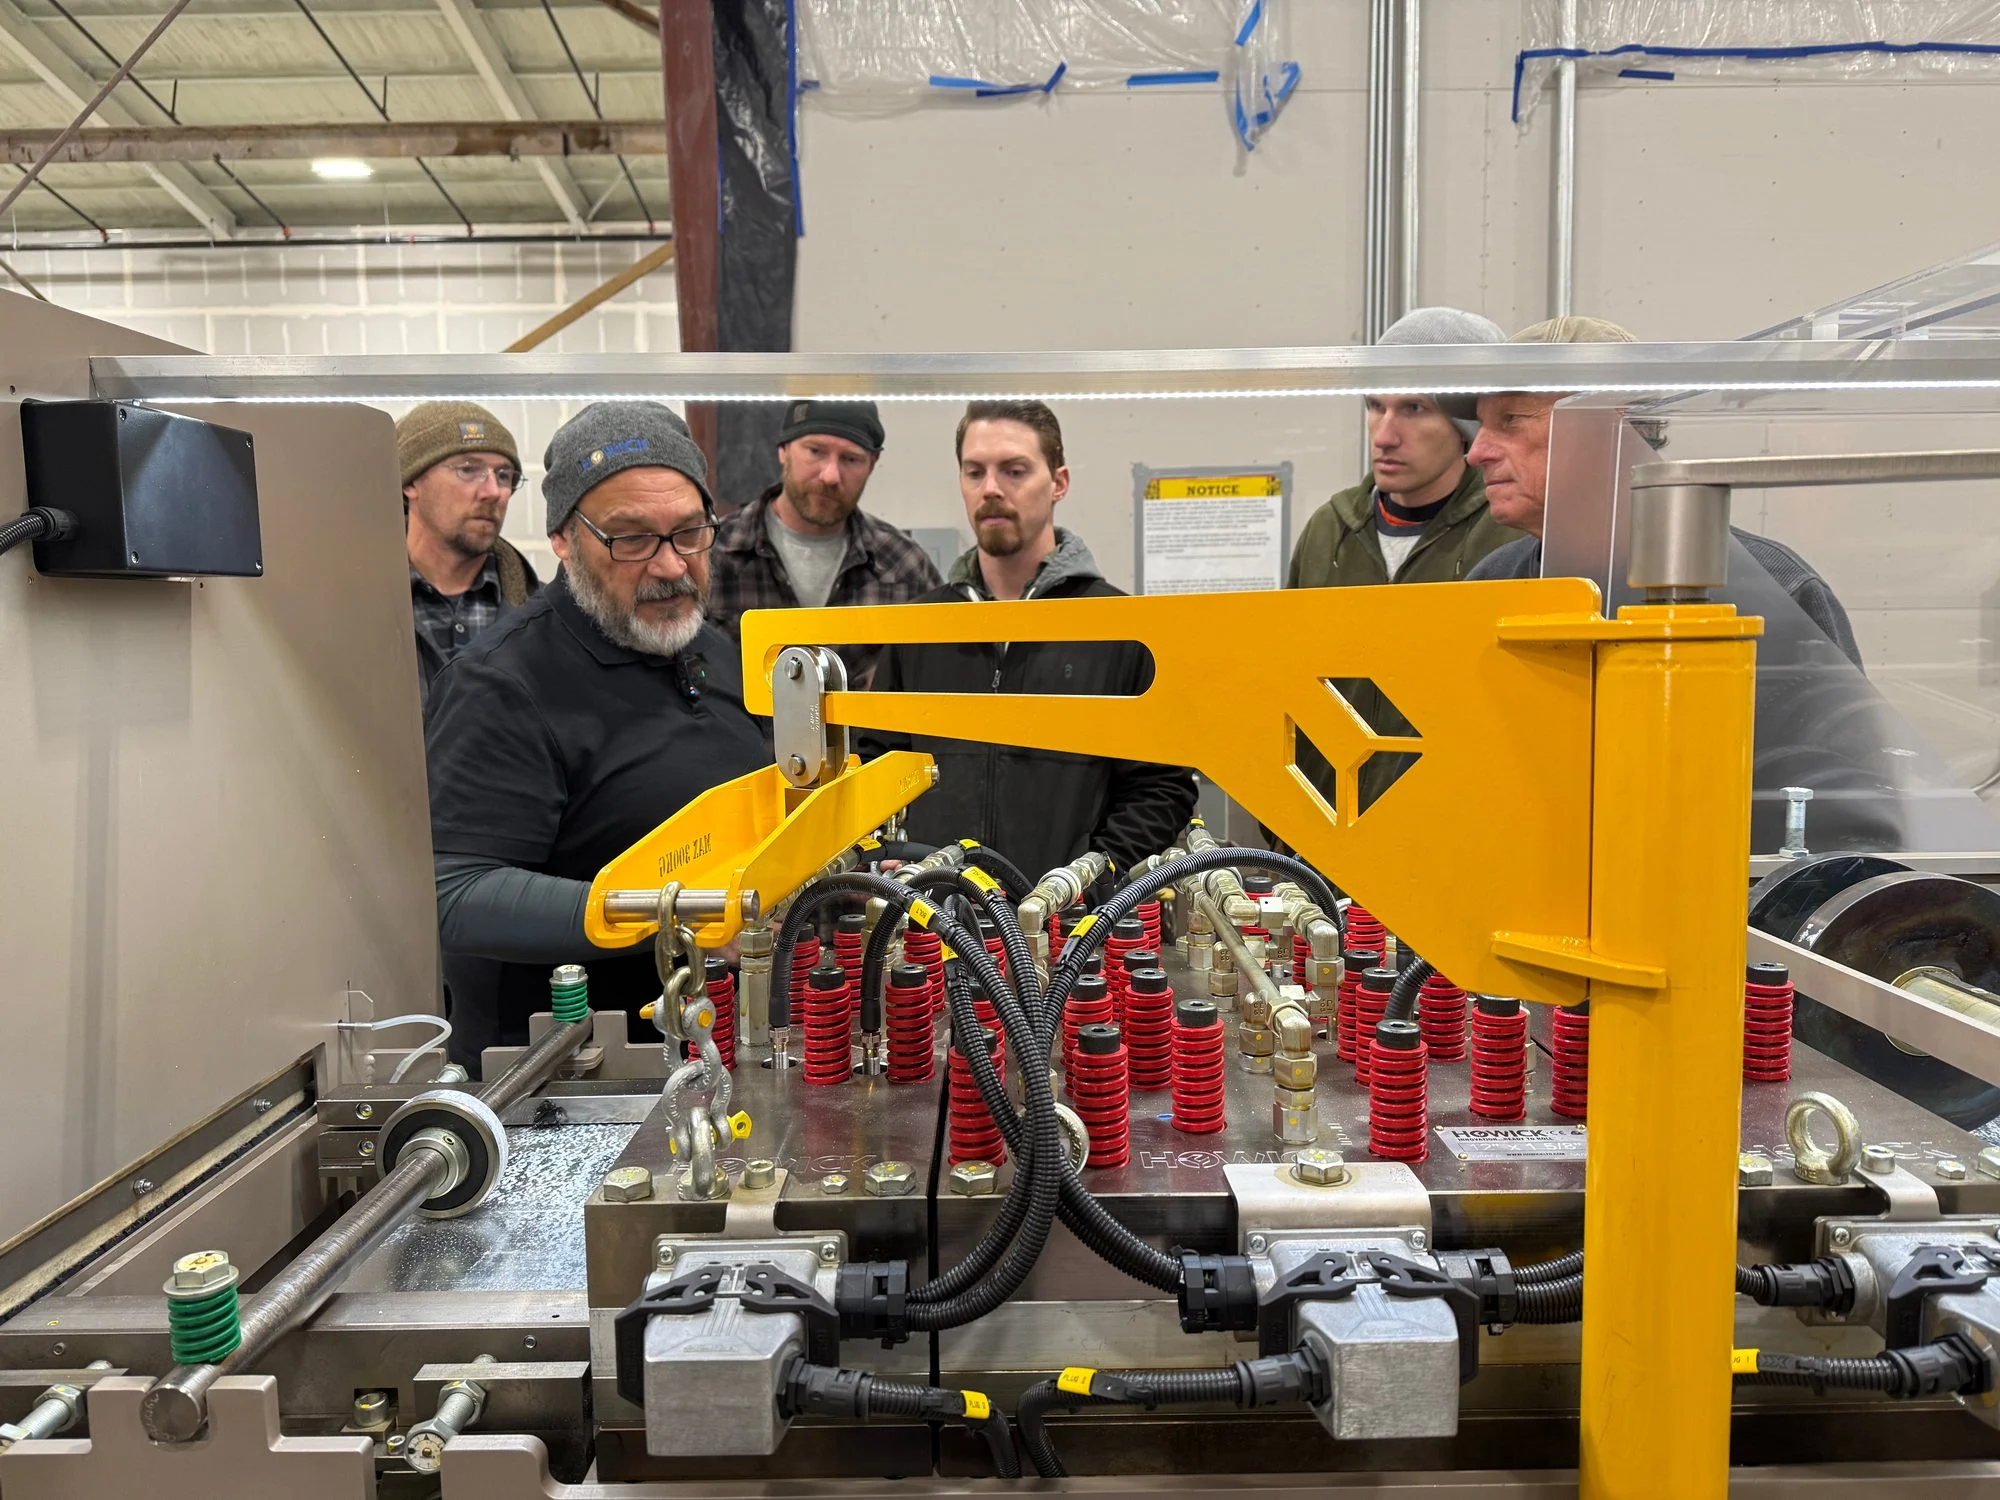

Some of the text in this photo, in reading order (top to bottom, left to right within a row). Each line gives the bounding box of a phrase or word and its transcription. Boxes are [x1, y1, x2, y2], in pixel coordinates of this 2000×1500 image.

[1186, 484, 1240, 497] NOTICE
[1452, 1129, 1547, 1138] HOWICK
[1063, 1373, 1080, 1383] PLUG
